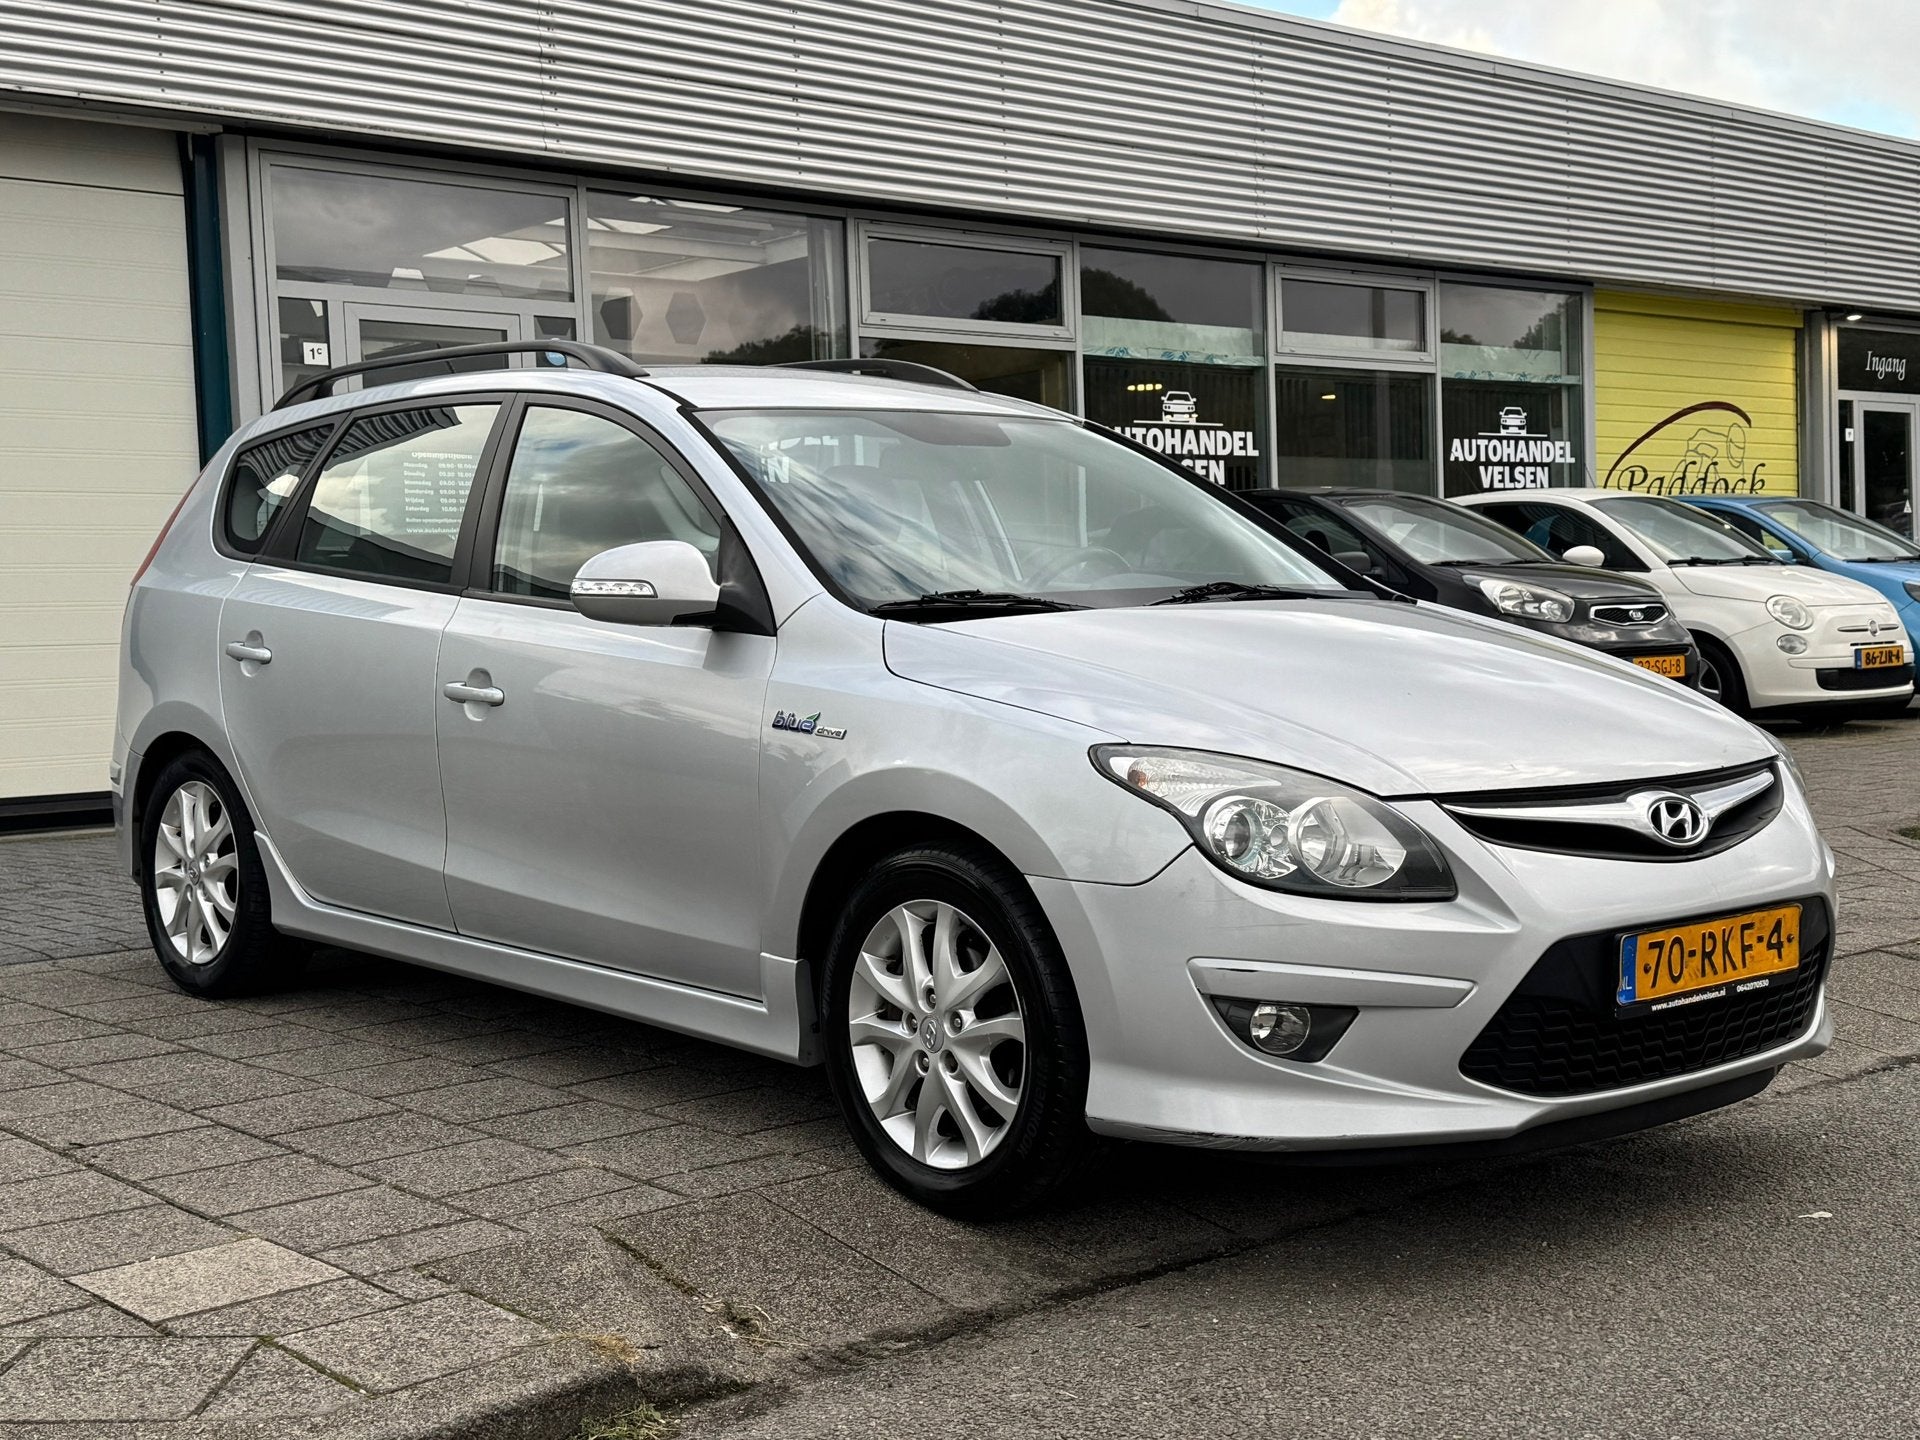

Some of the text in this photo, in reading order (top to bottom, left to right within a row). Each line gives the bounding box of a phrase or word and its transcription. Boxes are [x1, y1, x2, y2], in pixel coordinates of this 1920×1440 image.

[1865, 350, 1907, 381] Ingang
[1450, 438, 1576, 463] AUTOHANDEL
[1479, 465, 1549, 489] VELSEN
[1617, 460, 1766, 496] Paddock
[771, 710, 817, 735] blue
[1647, 917, 1785, 989] 70-RKF-4
